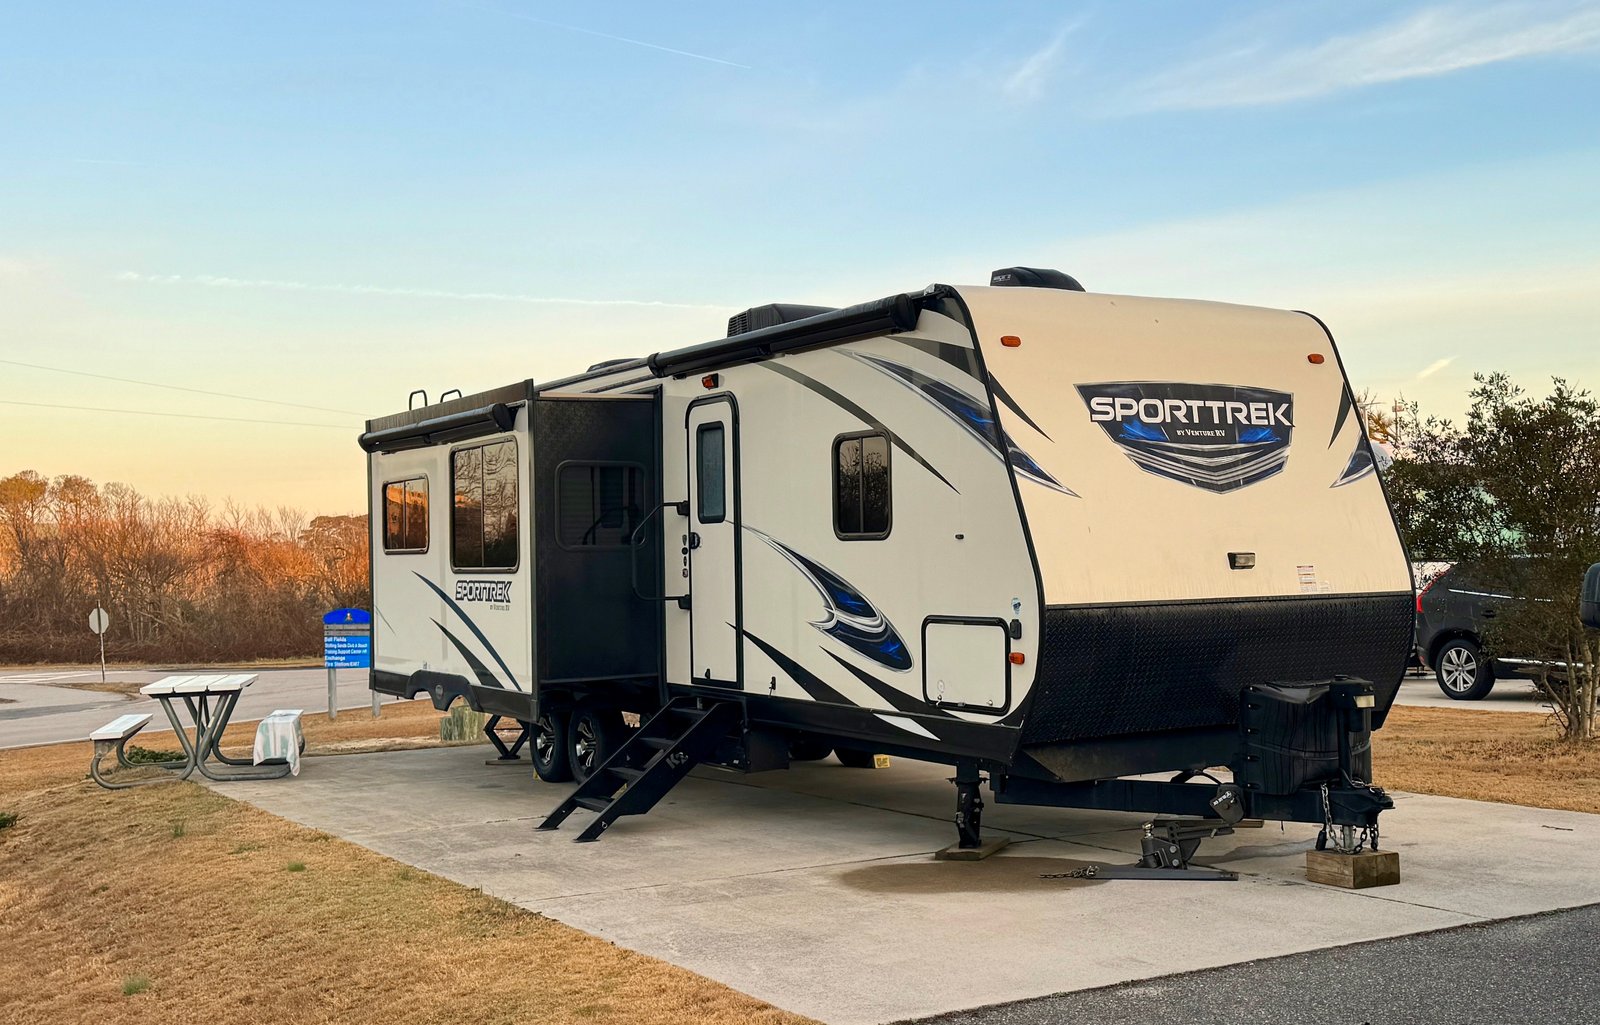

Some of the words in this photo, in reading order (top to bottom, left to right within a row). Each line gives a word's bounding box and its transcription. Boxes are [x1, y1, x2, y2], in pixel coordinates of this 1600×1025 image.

[1090, 397, 1292, 426] SPORTTREK
[1216, 429, 1225, 437] RV
[456, 581, 511, 602] SPORTTREK
